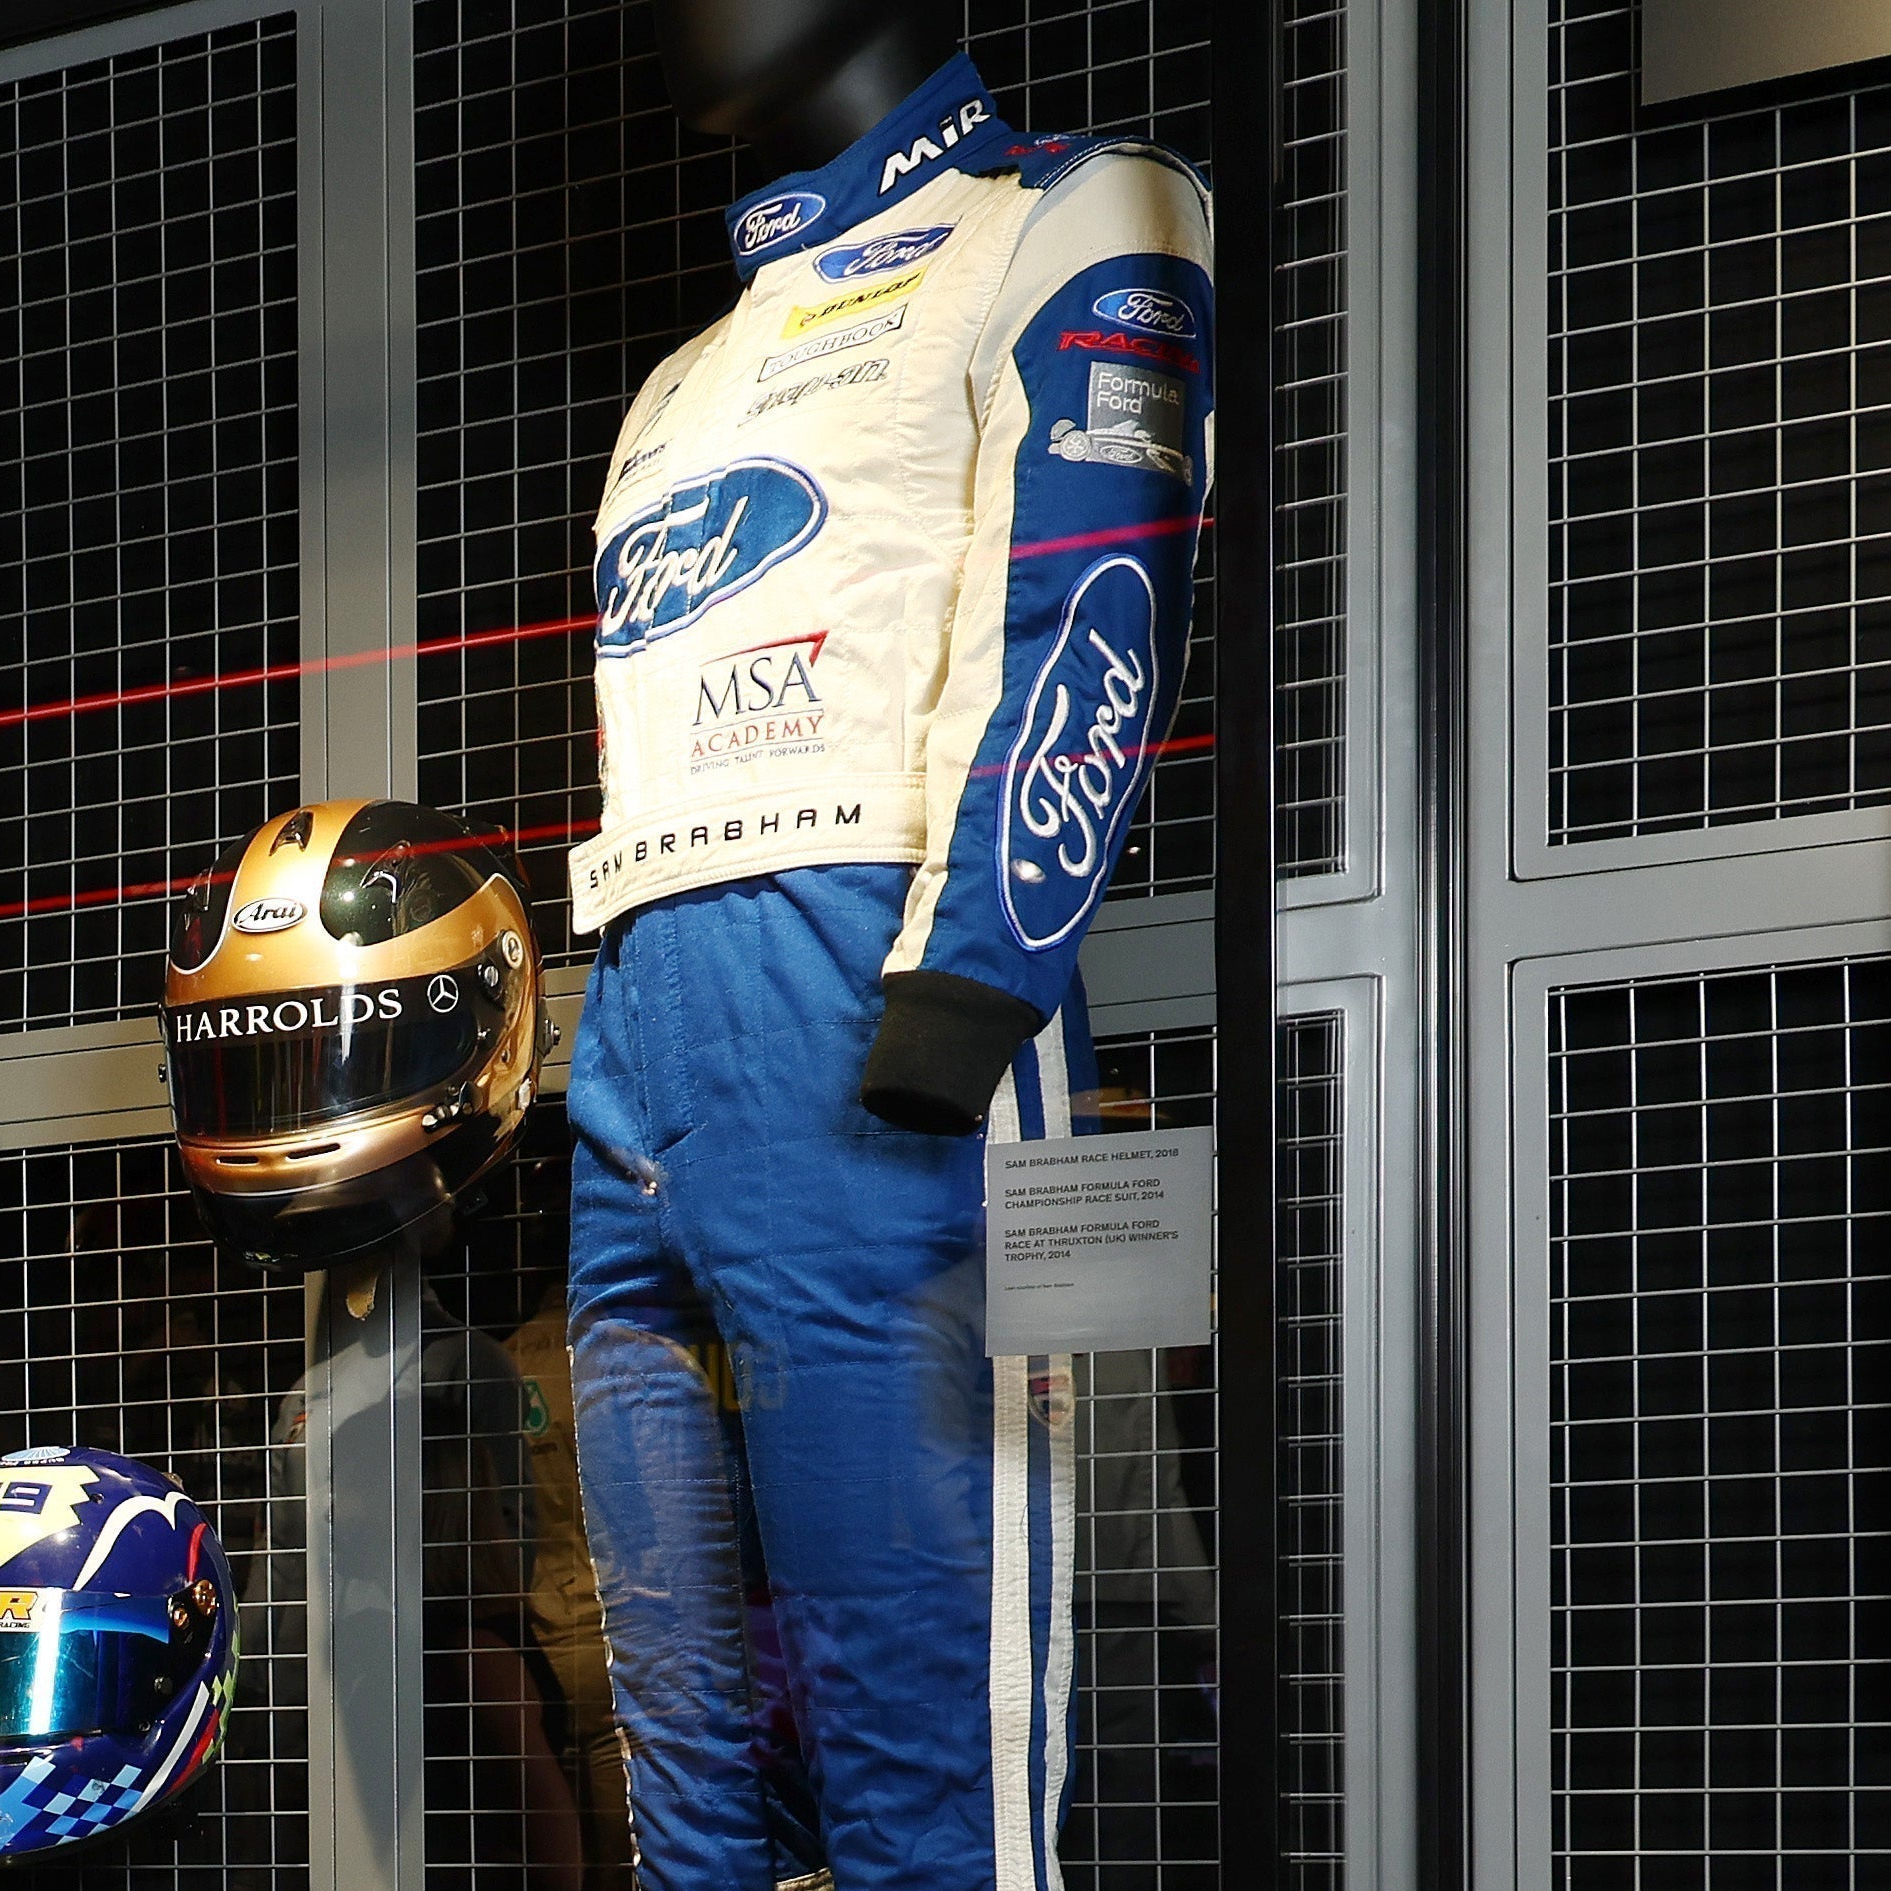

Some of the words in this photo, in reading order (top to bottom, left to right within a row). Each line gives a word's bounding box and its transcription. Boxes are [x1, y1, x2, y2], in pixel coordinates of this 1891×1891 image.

[744, 202, 802, 249] Ford
[1119, 294, 1185, 331] Ford
[768, 318, 896, 372] TOUGHBOOK
[1096, 392, 1143, 414] Ford
[1098, 372, 1179, 404] Formula
[601, 497, 749, 634] Ford
[692, 651, 823, 726] MSA
[692, 715, 825, 758] ACADEMY
[1020, 628, 1147, 879] Ford
[589, 851, 622, 889] SAM
[635, 803, 861, 862] BRABHAM
[247, 902, 302, 925] Arai
[177, 988, 403, 1043] HARROLDS
[1005, 1159, 1027, 1169] SAM
[1029, 1156, 1079, 1167] BRABHAM
[1081, 1153, 1108, 1163] RACE
[1111, 1150, 1154, 1161] HELMET,
[1005, 1188, 1026, 1198] SAM
[1028, 1184, 1079, 1195] BRABHAM
[1081, 1181, 1130, 1191] FORMULA
[1132, 1179, 1160, 1188] FORD
[1005, 1196, 1083, 1209] CHAMPIONSHIP
[1085, 1194, 1112, 1204] RACE
[1141, 1190, 1165, 1200] 2014
[1005, 1251, 1047, 1262] TROPHY,
[1048, 1250, 1071, 1259] 2014
